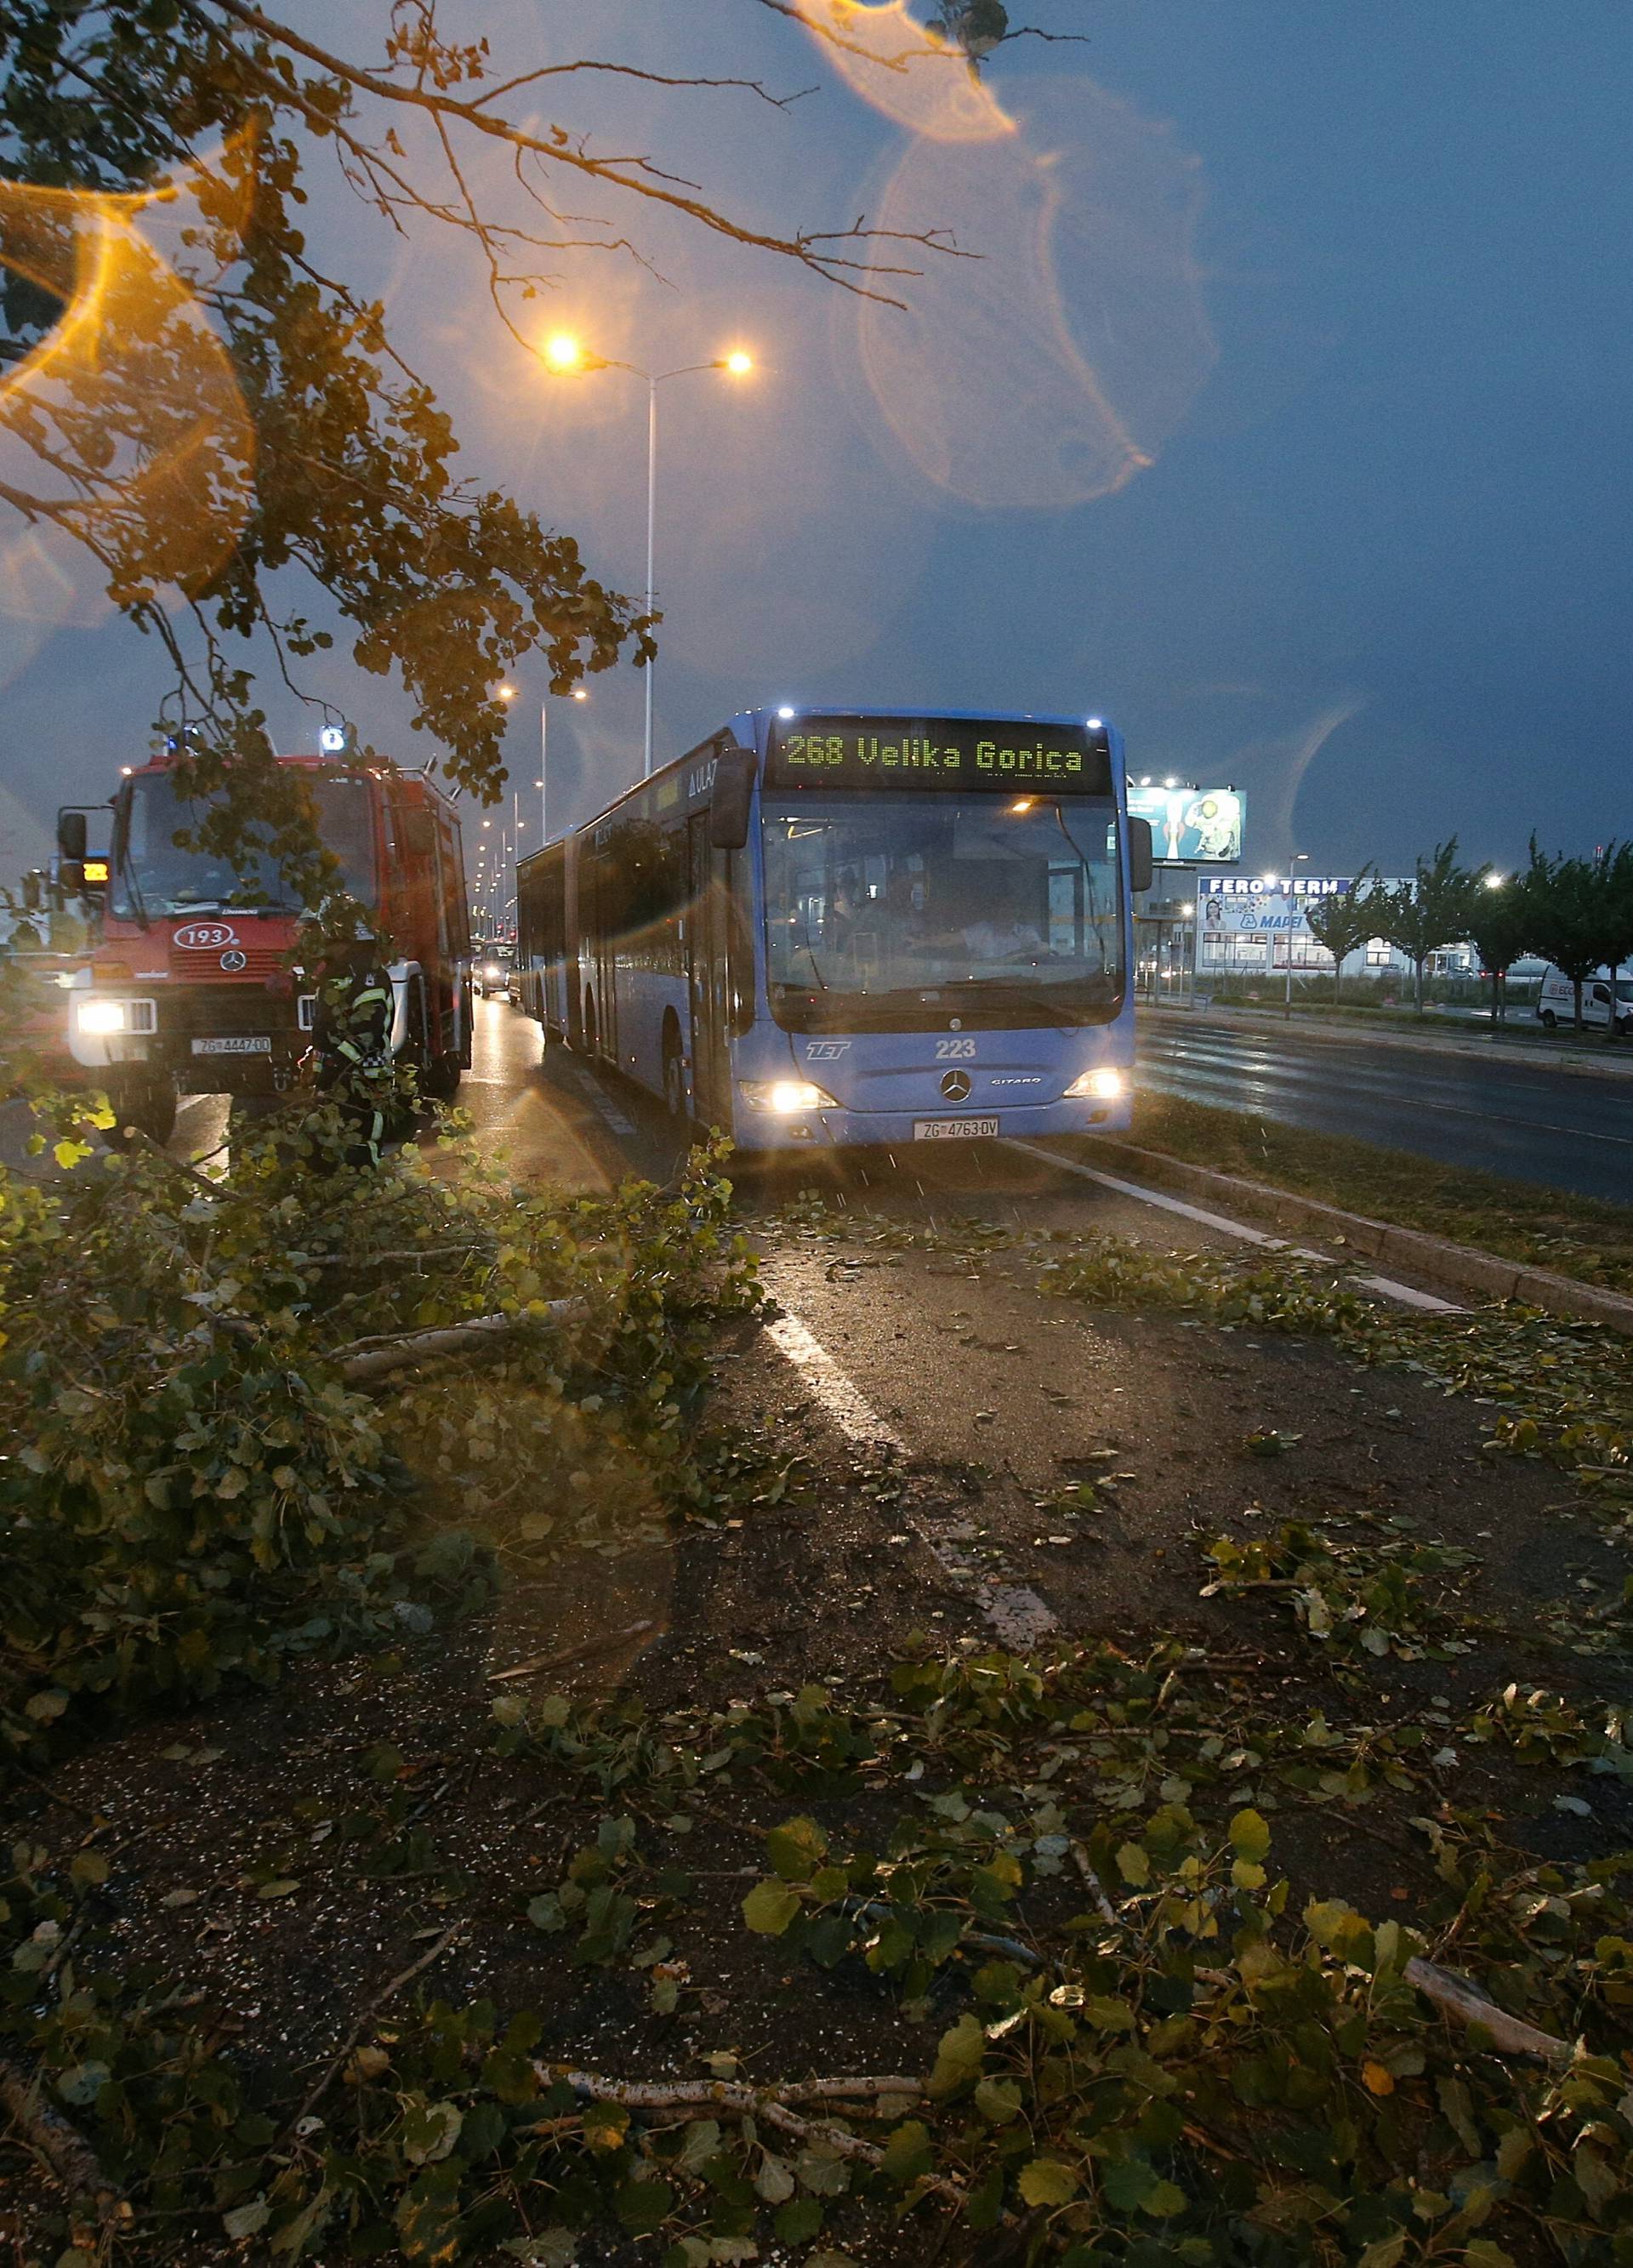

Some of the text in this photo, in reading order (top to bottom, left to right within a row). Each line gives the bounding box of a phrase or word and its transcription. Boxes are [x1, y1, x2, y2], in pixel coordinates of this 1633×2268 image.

[787, 735, 1083, 772] 268 Velika Gorica
[1260, 915, 1303, 929] MAPEI
[187, 929, 223, 944] 193
[936, 1038, 976, 1059] 223
[924, 1124, 940, 1138] ZG
